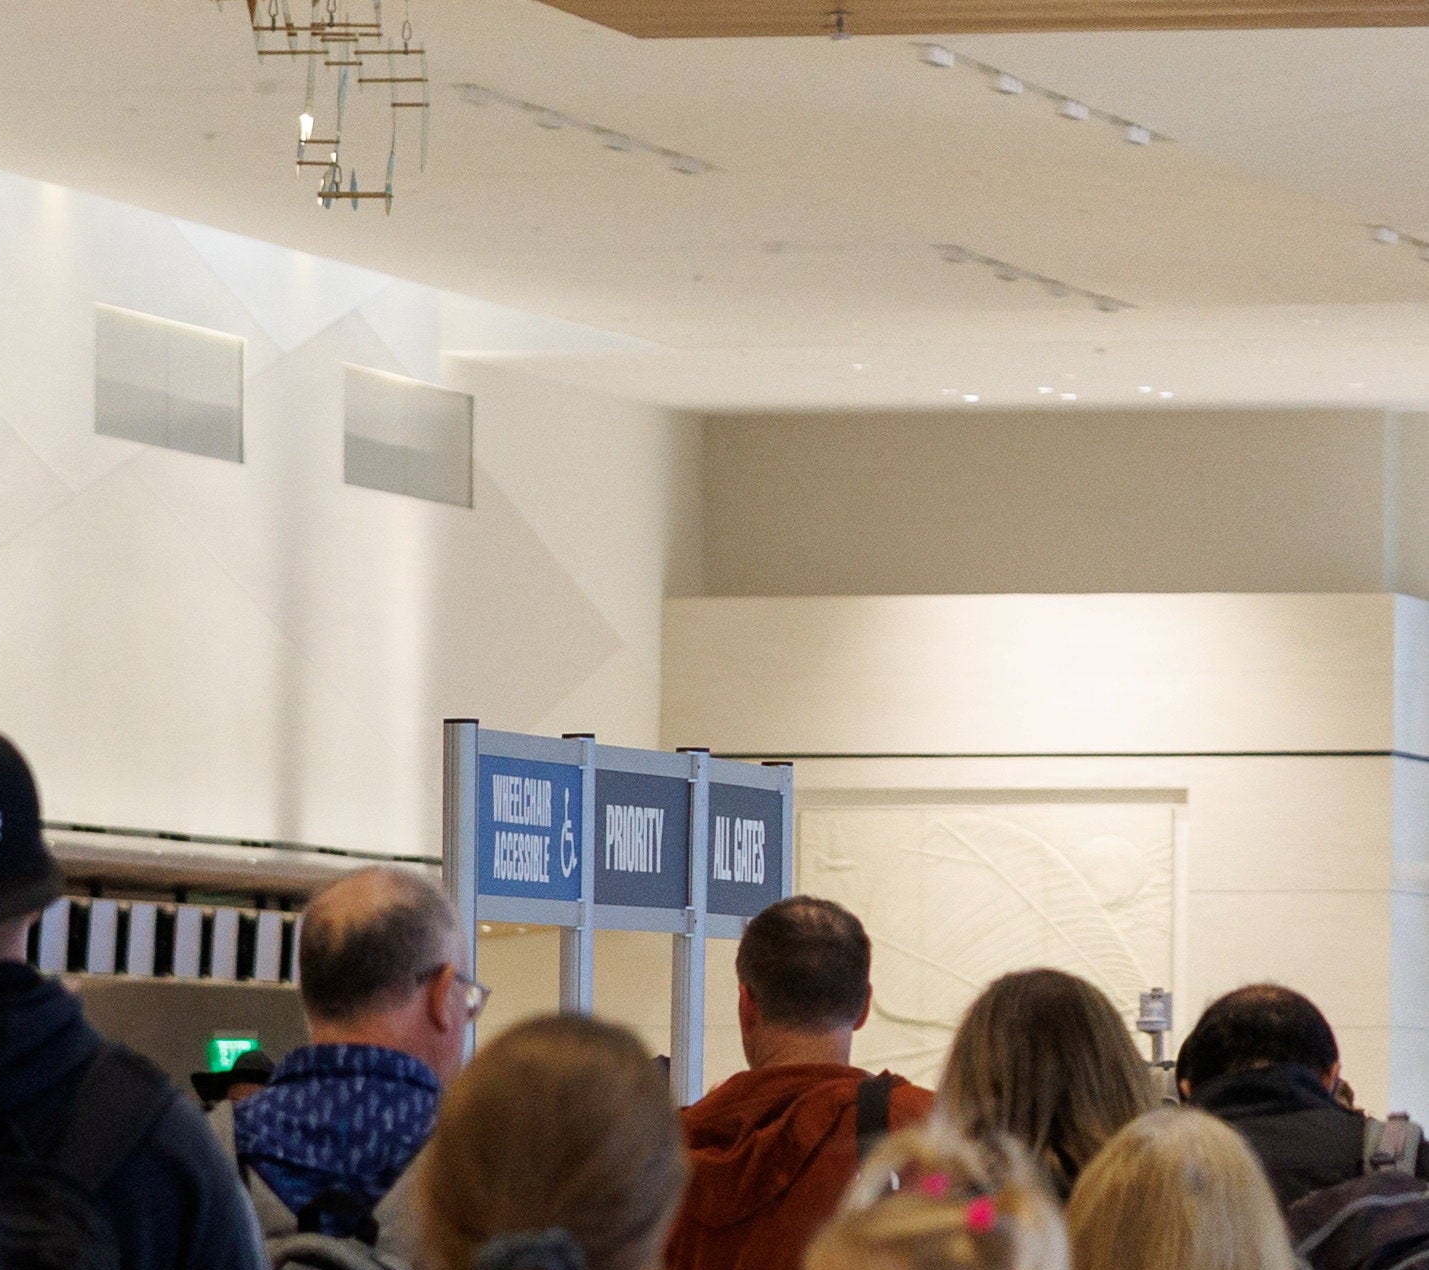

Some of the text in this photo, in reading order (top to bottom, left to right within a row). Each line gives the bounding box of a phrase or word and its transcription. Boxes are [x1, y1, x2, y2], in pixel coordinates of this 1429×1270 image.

[492, 774, 552, 828] WHEELCHAIR
[493, 830, 551, 884] ACCESSIBLE
[605, 804, 665, 874] PRIORITY
[713, 815, 766, 885] ALL GATES
